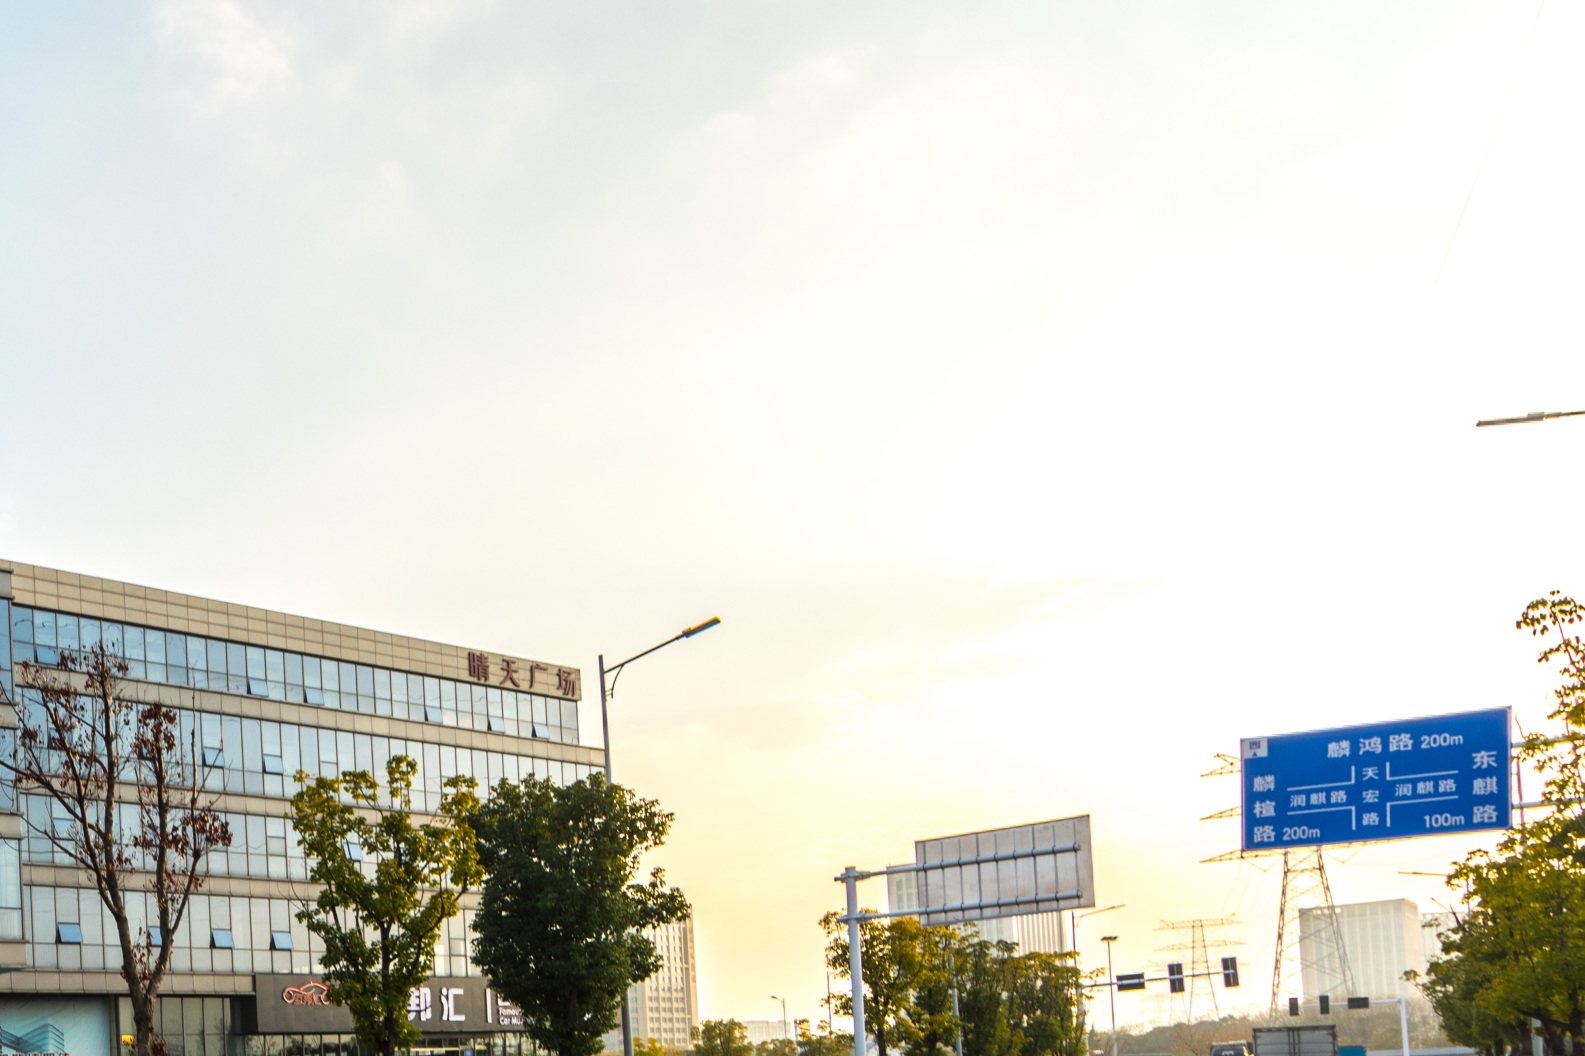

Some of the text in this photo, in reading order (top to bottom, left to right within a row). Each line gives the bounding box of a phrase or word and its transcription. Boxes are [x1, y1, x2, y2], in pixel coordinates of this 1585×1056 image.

[468, 651, 577, 697] 晴天广场
[1327, 733, 1464, 759] 麟鸿路 200m
[1472, 751, 1499, 824] 东麒路
[1282, 827, 1321, 841] 200m
[1423, 813, 1465, 829] 100m
[391, 986, 466, 1022] 邦汇
